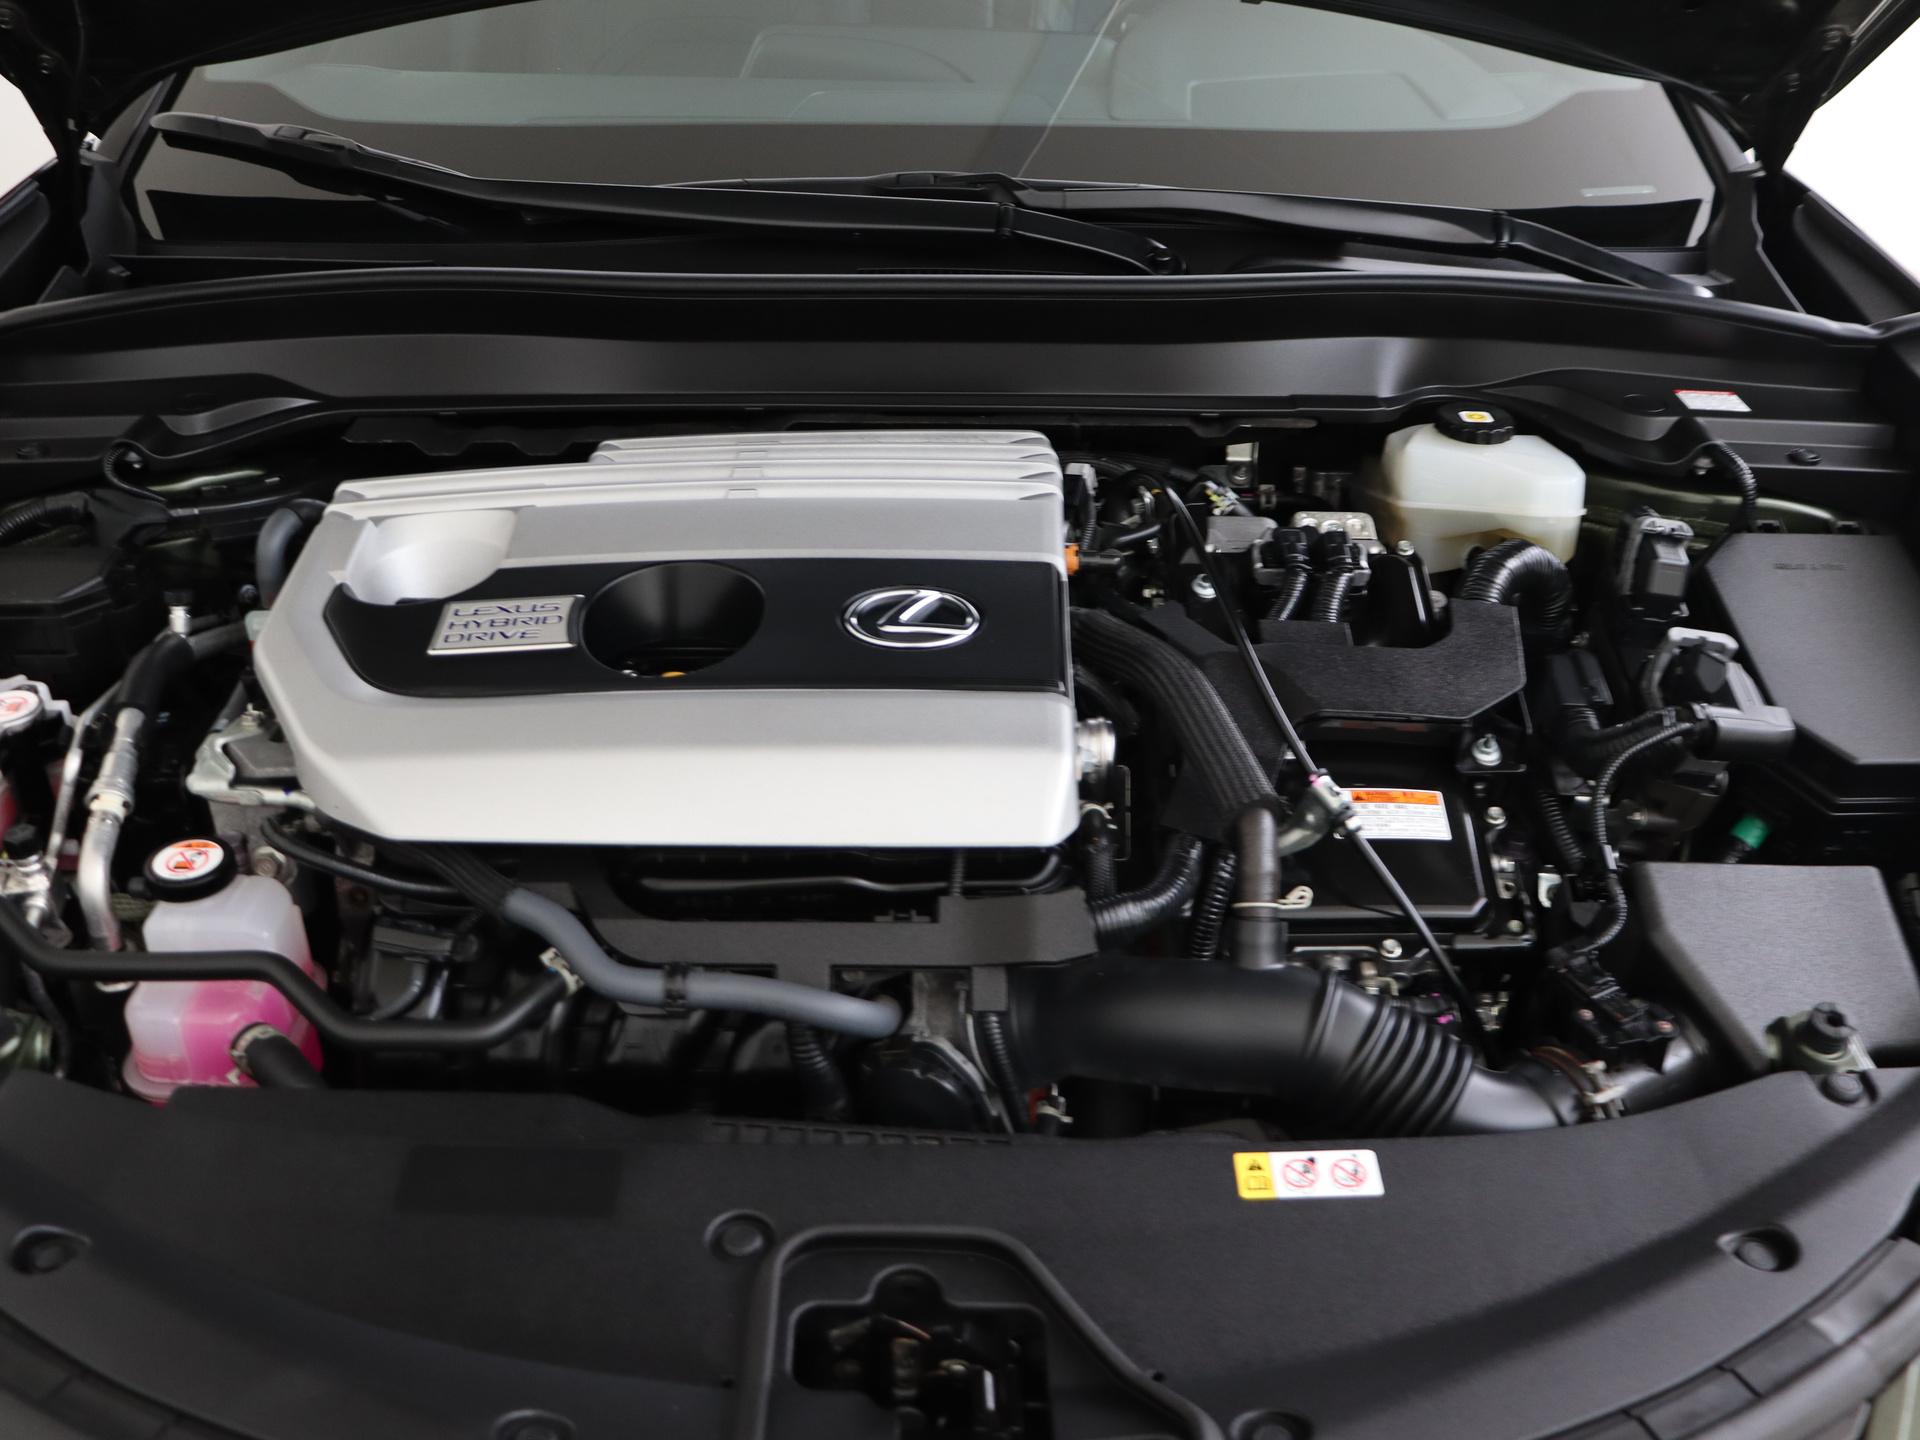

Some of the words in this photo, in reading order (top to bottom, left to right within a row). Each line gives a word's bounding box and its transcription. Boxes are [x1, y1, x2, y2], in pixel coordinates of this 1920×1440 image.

[453, 603, 561, 616] LEXUS
[448, 615, 564, 629] HYBRID
[444, 628, 542, 643] DRIVE
